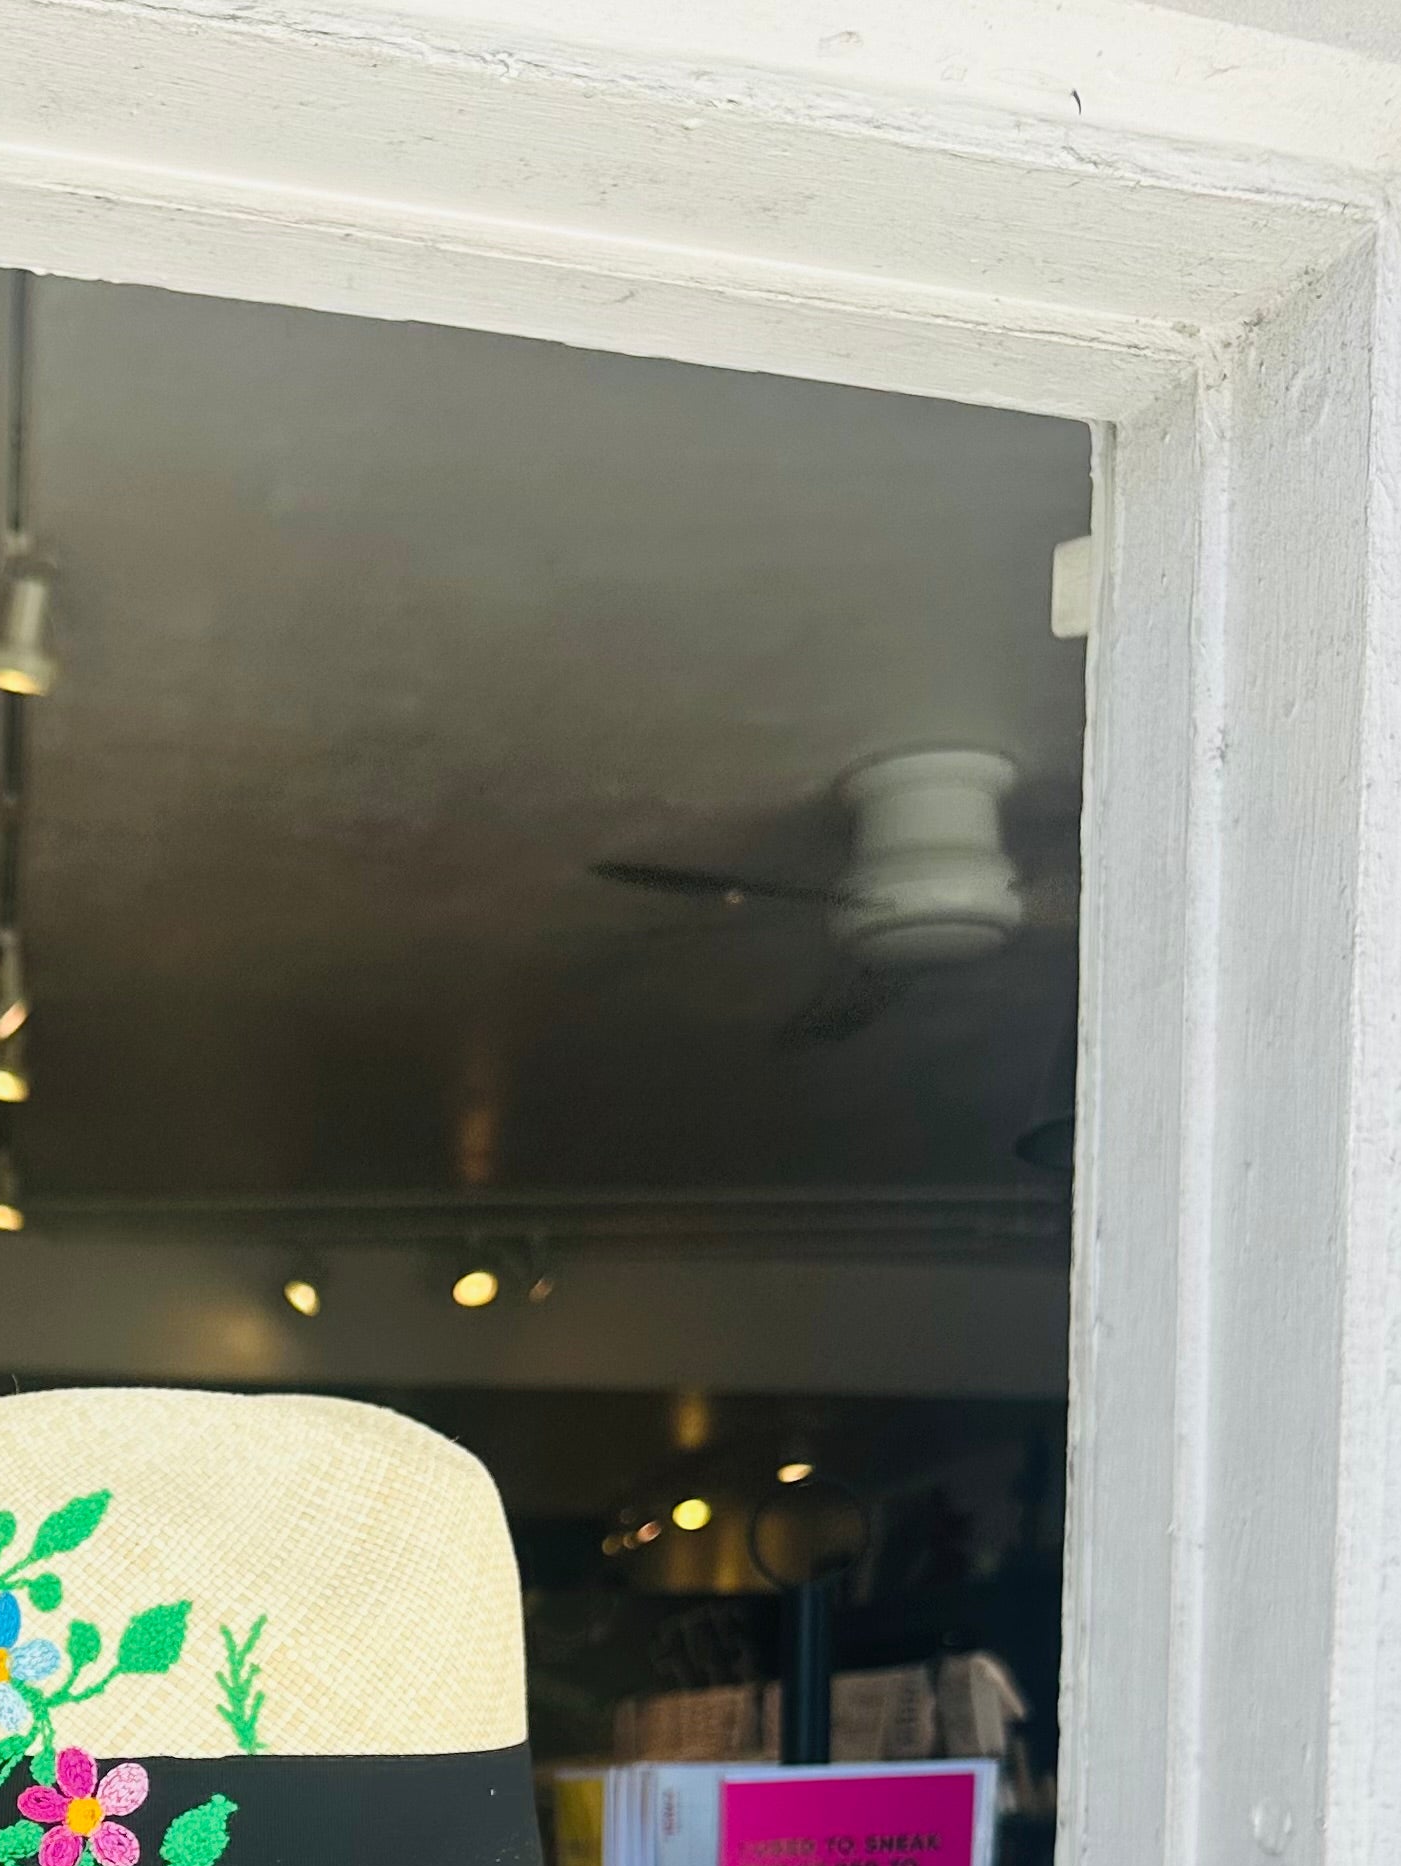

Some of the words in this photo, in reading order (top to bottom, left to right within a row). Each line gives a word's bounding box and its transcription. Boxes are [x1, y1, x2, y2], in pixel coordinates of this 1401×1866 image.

[753, 1838, 817, 1857] USED
[825, 1835, 855, 1855] TO
[865, 1832, 942, 1854] SNEAK
